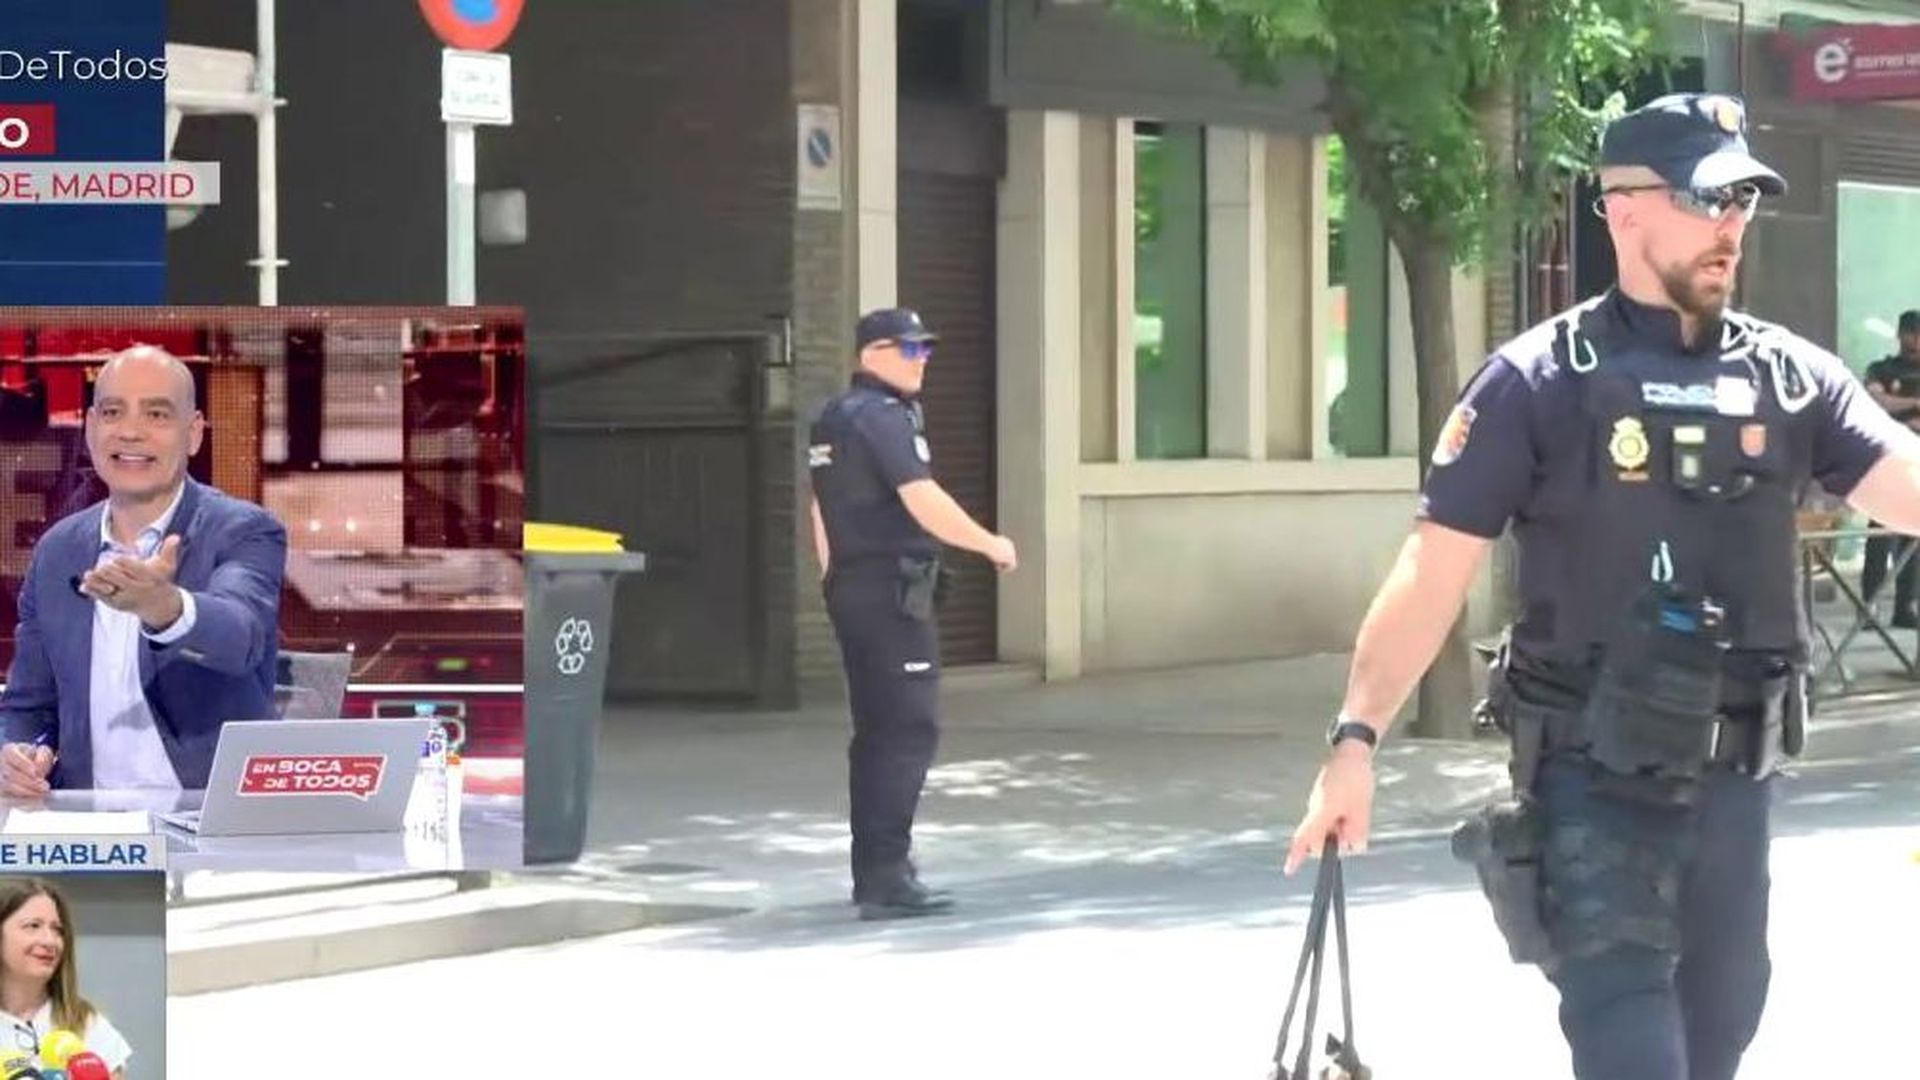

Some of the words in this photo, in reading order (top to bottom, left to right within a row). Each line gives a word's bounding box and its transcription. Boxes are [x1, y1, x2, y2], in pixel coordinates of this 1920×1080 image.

[252, 762, 276, 774] EN
[278, 759, 342, 774] BOCA
[293, 775, 371, 789] TODOS
